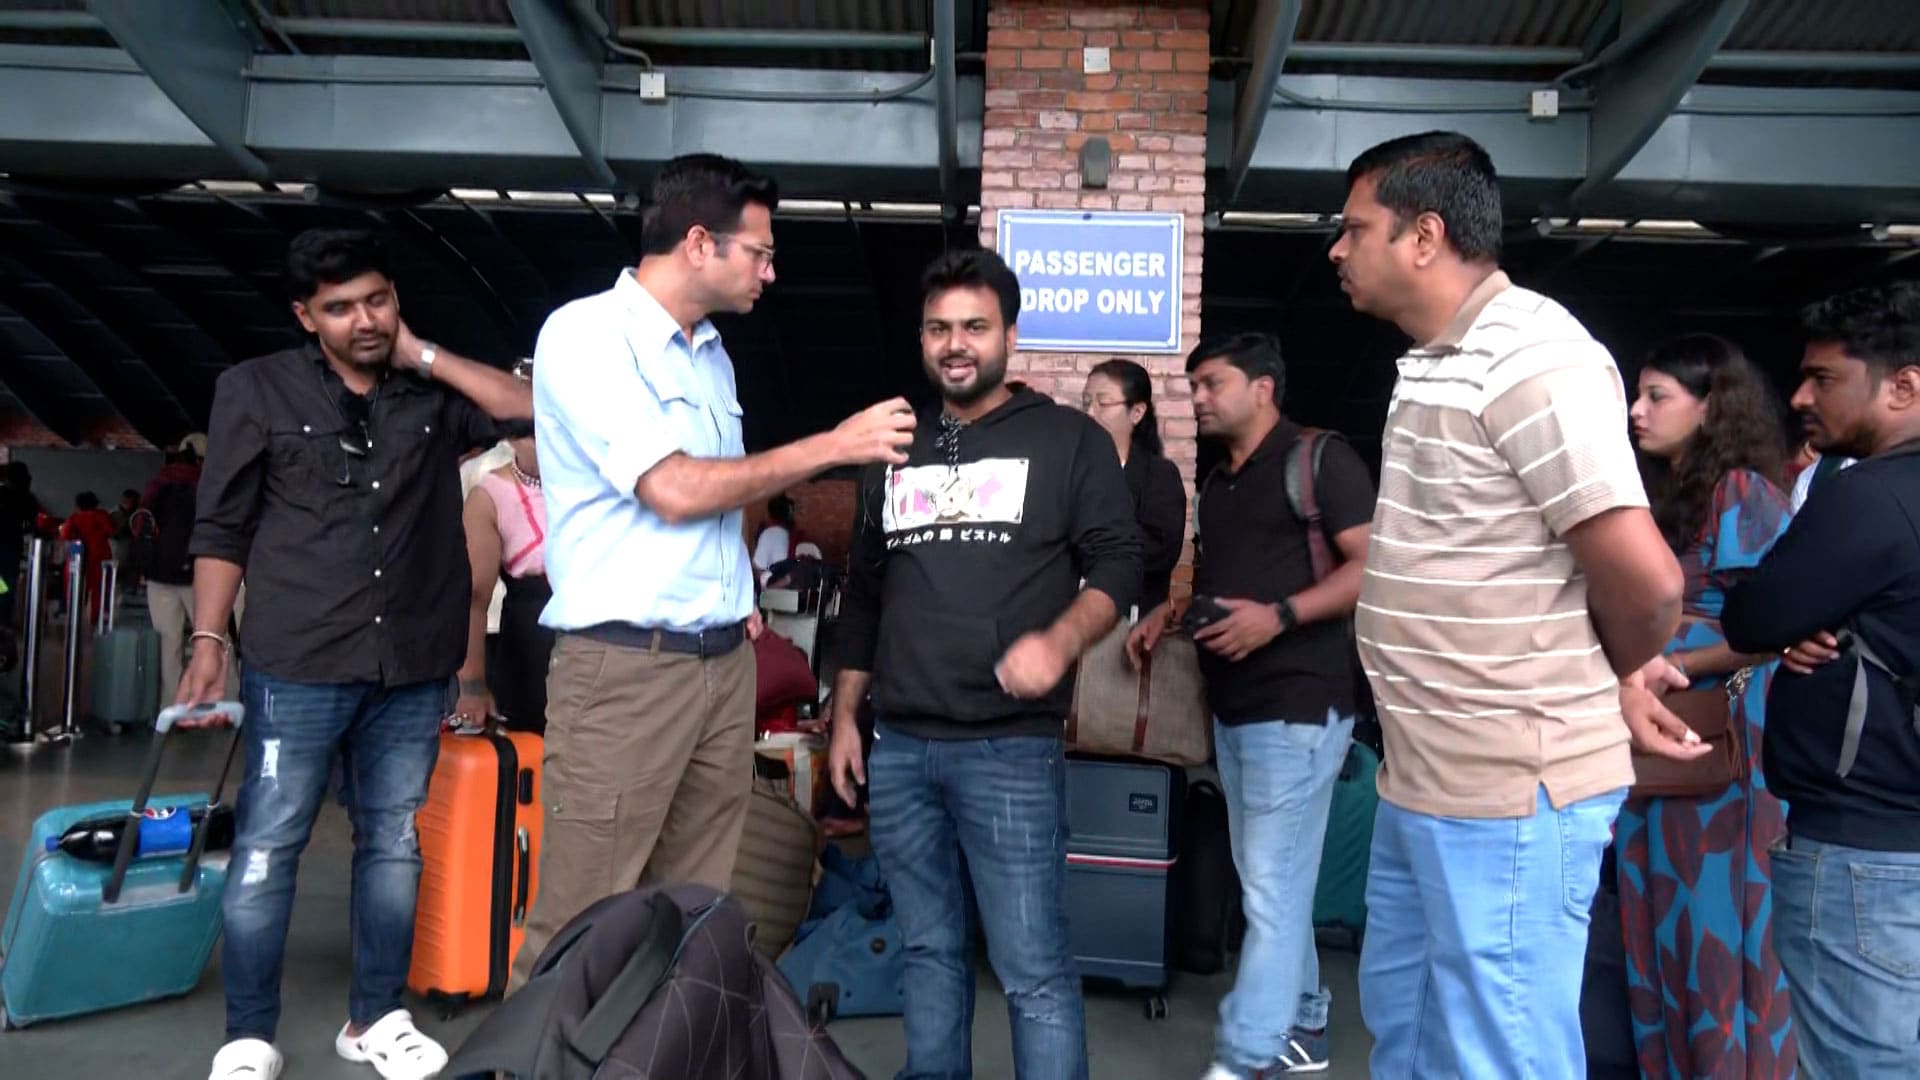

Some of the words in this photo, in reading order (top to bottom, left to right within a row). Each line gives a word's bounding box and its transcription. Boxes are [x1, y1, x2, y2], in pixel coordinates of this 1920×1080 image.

[1014, 250, 1165, 277] PASSENGER
[1020, 287, 1089, 313] DROP
[1096, 289, 1165, 315] ONLY
